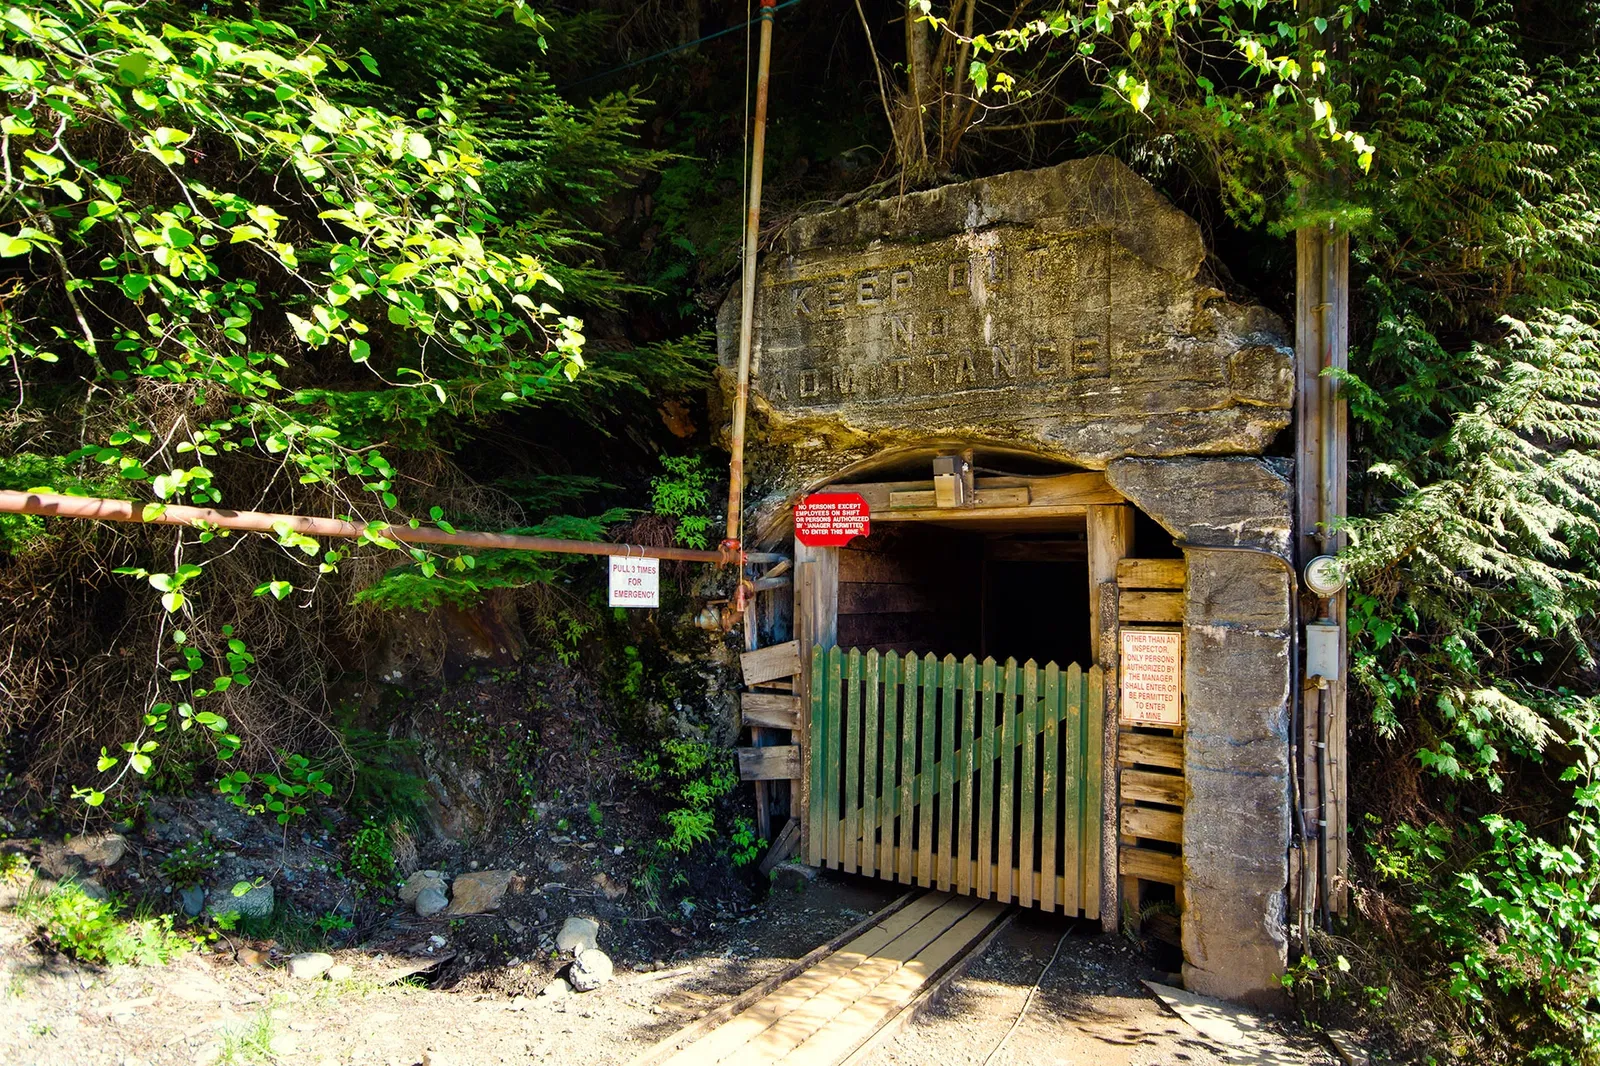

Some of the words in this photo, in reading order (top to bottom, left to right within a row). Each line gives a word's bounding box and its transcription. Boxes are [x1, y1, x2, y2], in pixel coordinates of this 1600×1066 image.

[791, 270, 914, 314] KEEP
[891, 309, 949, 347] NO
[637, 566, 656, 574] TIMES
[614, 590, 655, 598] EMERGENCY
[1145, 655, 1174, 663] PERSONS
[1142, 674, 1172, 682] MANAGER
[1125, 682, 1144, 690] SHALL
[1146, 683, 1166, 691] ENTER
[1138, 692, 1173, 701] PERMITTED
